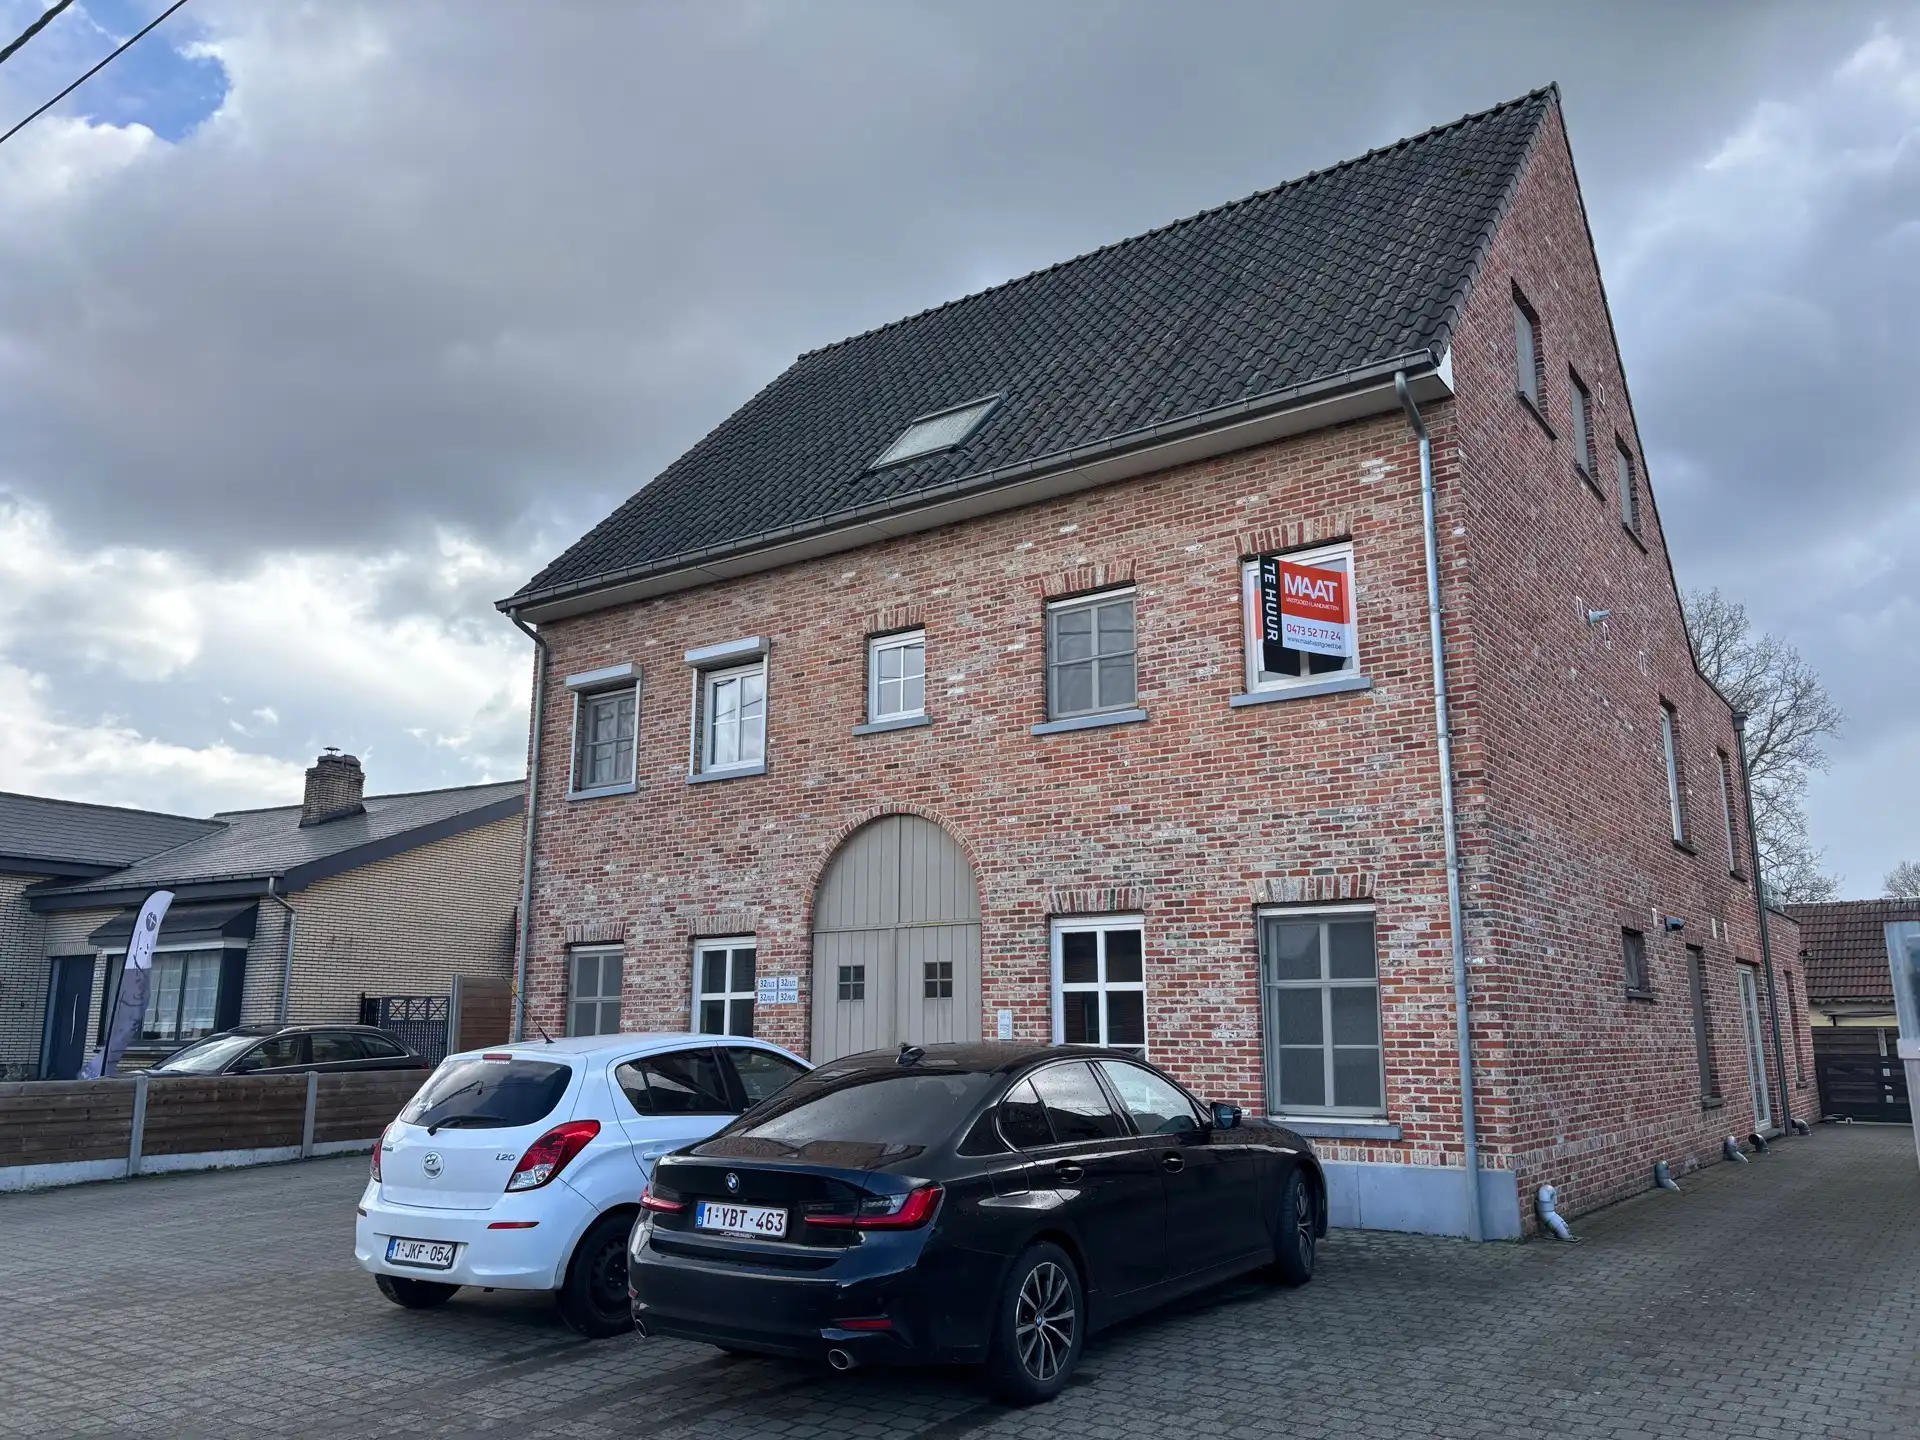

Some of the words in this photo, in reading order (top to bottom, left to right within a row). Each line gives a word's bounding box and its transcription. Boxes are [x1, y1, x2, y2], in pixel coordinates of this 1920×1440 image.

[1263, 562, 1276, 585] TE
[1283, 572, 1338, 603] MAAT
[1265, 588, 1278, 641] HUUR
[1286, 623, 1306, 636] 0473
[1307, 627, 1318, 638] 52
[1319, 628, 1329, 640] 77
[1330, 630, 1341, 641] 24
[697, 1216, 703, 1225] B
